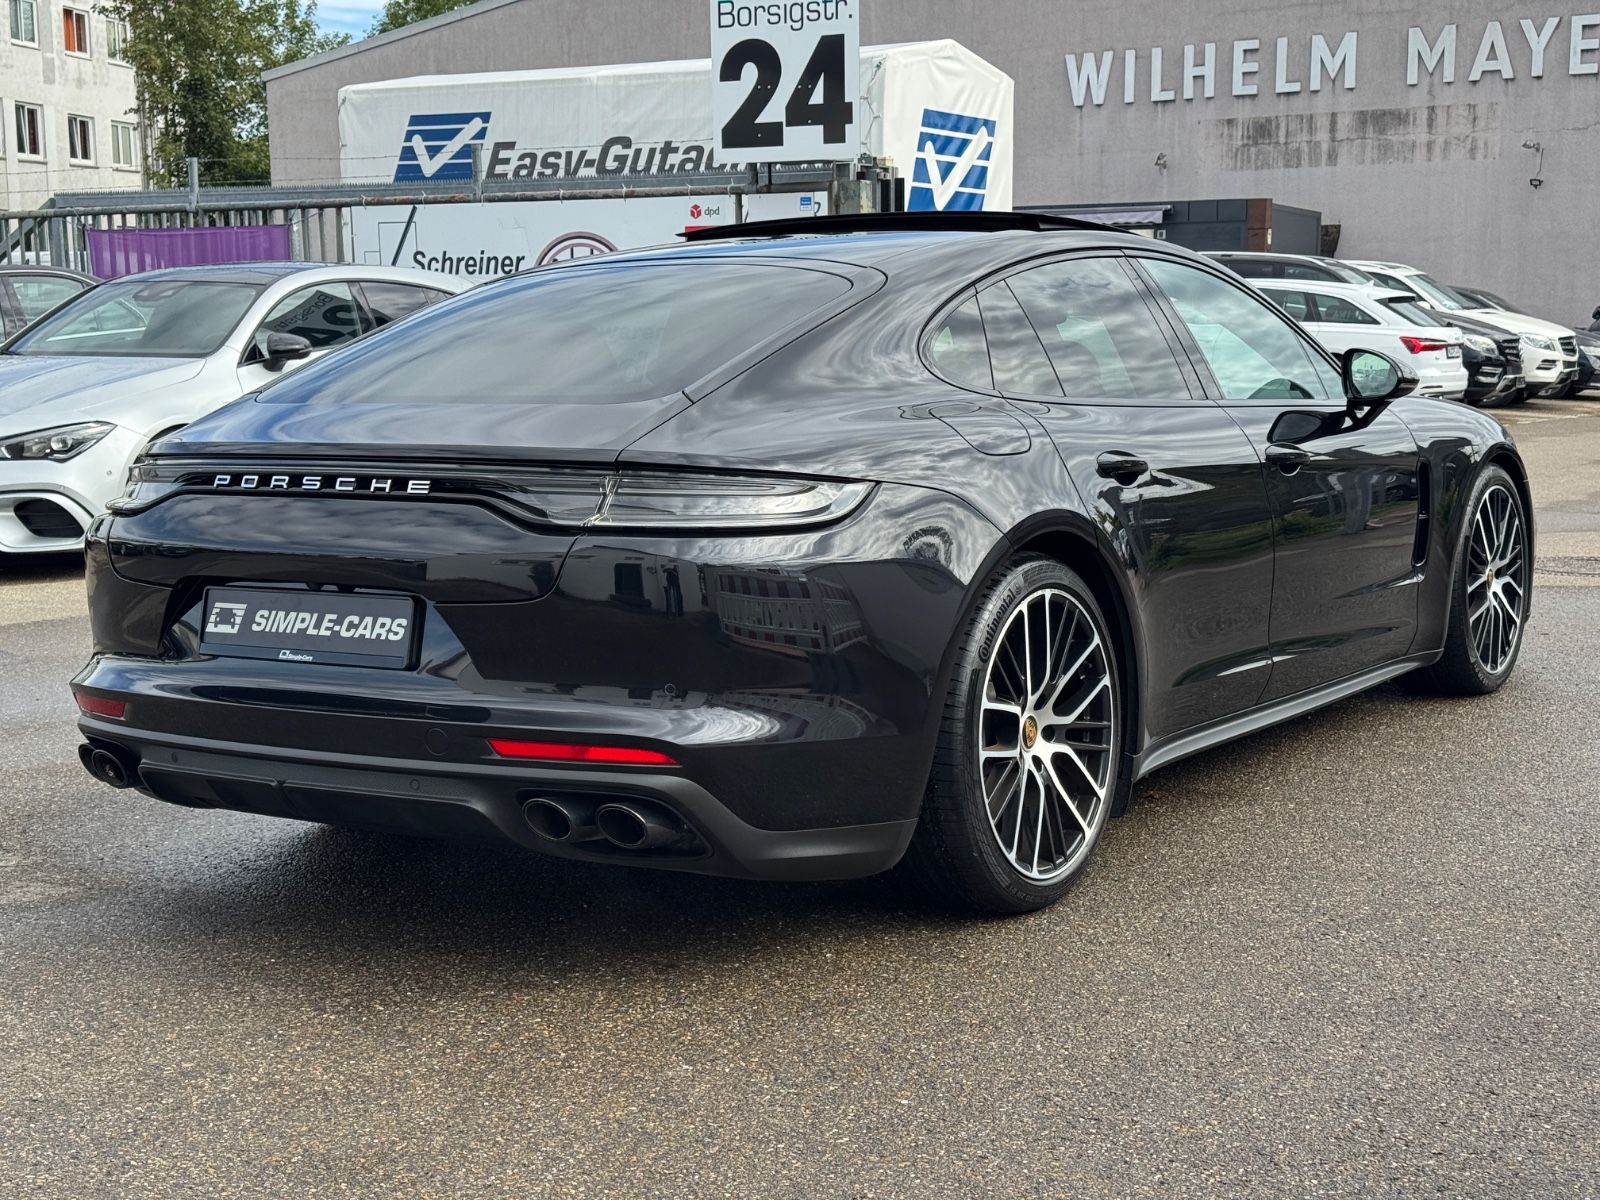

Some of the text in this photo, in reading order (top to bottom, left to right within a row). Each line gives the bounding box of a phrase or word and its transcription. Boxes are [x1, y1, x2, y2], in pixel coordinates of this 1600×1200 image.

[717, 0, 853, 31] Borsigstr.
[1064, 13, 1600, 107] WILHELM MAYE
[719, 33, 853, 149] 24
[704, 206, 720, 218] dpd
[412, 250, 525, 275] Schreiner
[213, 474, 432, 495] PORSCHE
[251, 609, 408, 641] SIMPLE-CARS
[978, 587, 1017, 664] Continental
